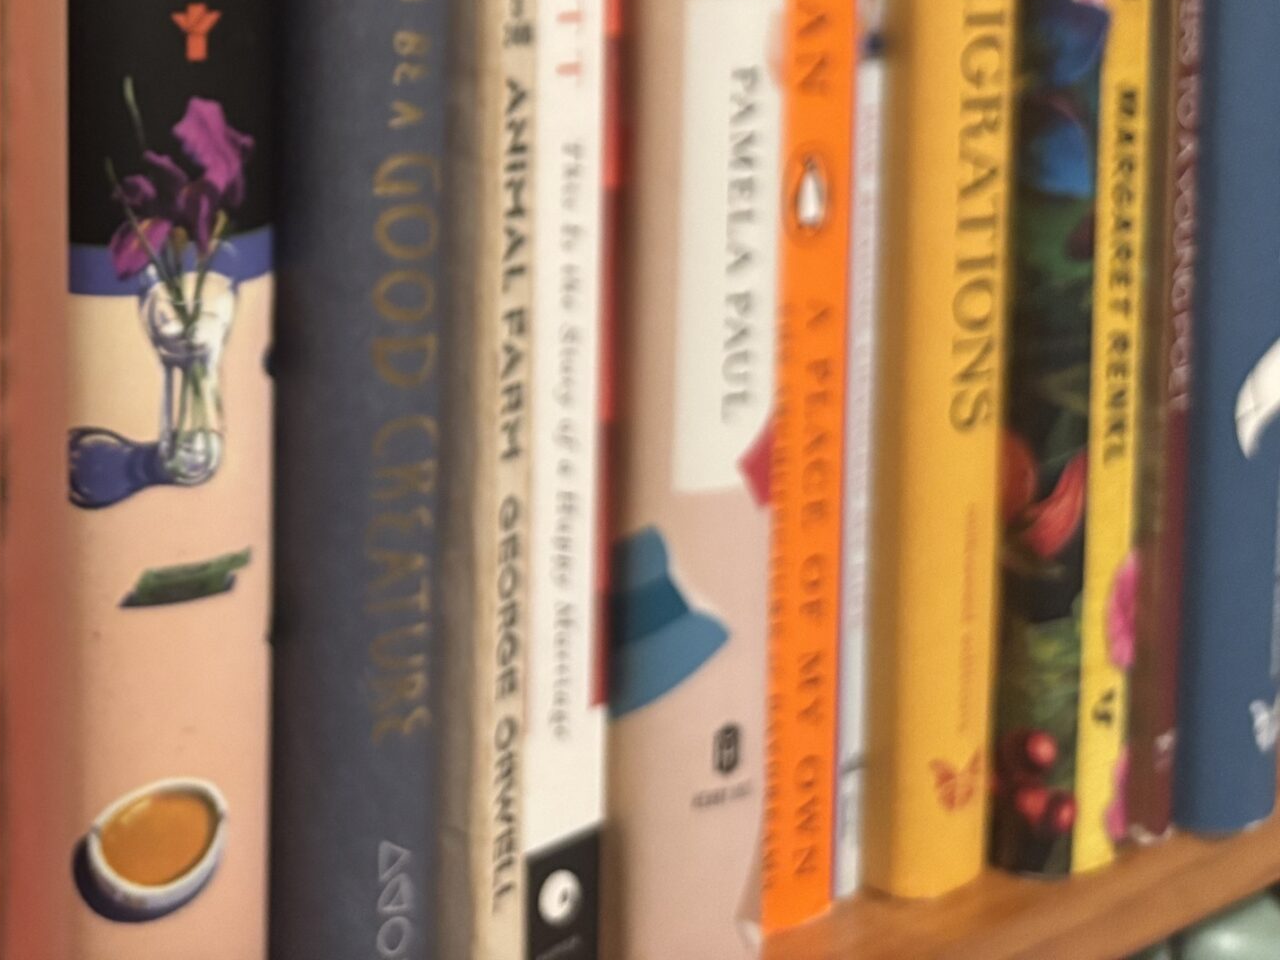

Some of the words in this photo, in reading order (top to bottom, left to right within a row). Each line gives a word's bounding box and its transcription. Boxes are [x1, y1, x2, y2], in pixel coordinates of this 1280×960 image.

[371, 151, 444, 391] GOOD
[500, 76, 529, 294] ANIMAL
[724, 64, 761, 279] PAMELA
[498, 306, 528, 463] FARM
[720, 289, 756, 425] PAUL
[494, 495, 524, 702] GEORGE
[491, 715, 521, 916] ORWELL
[792, 753, 823, 878] OWN
